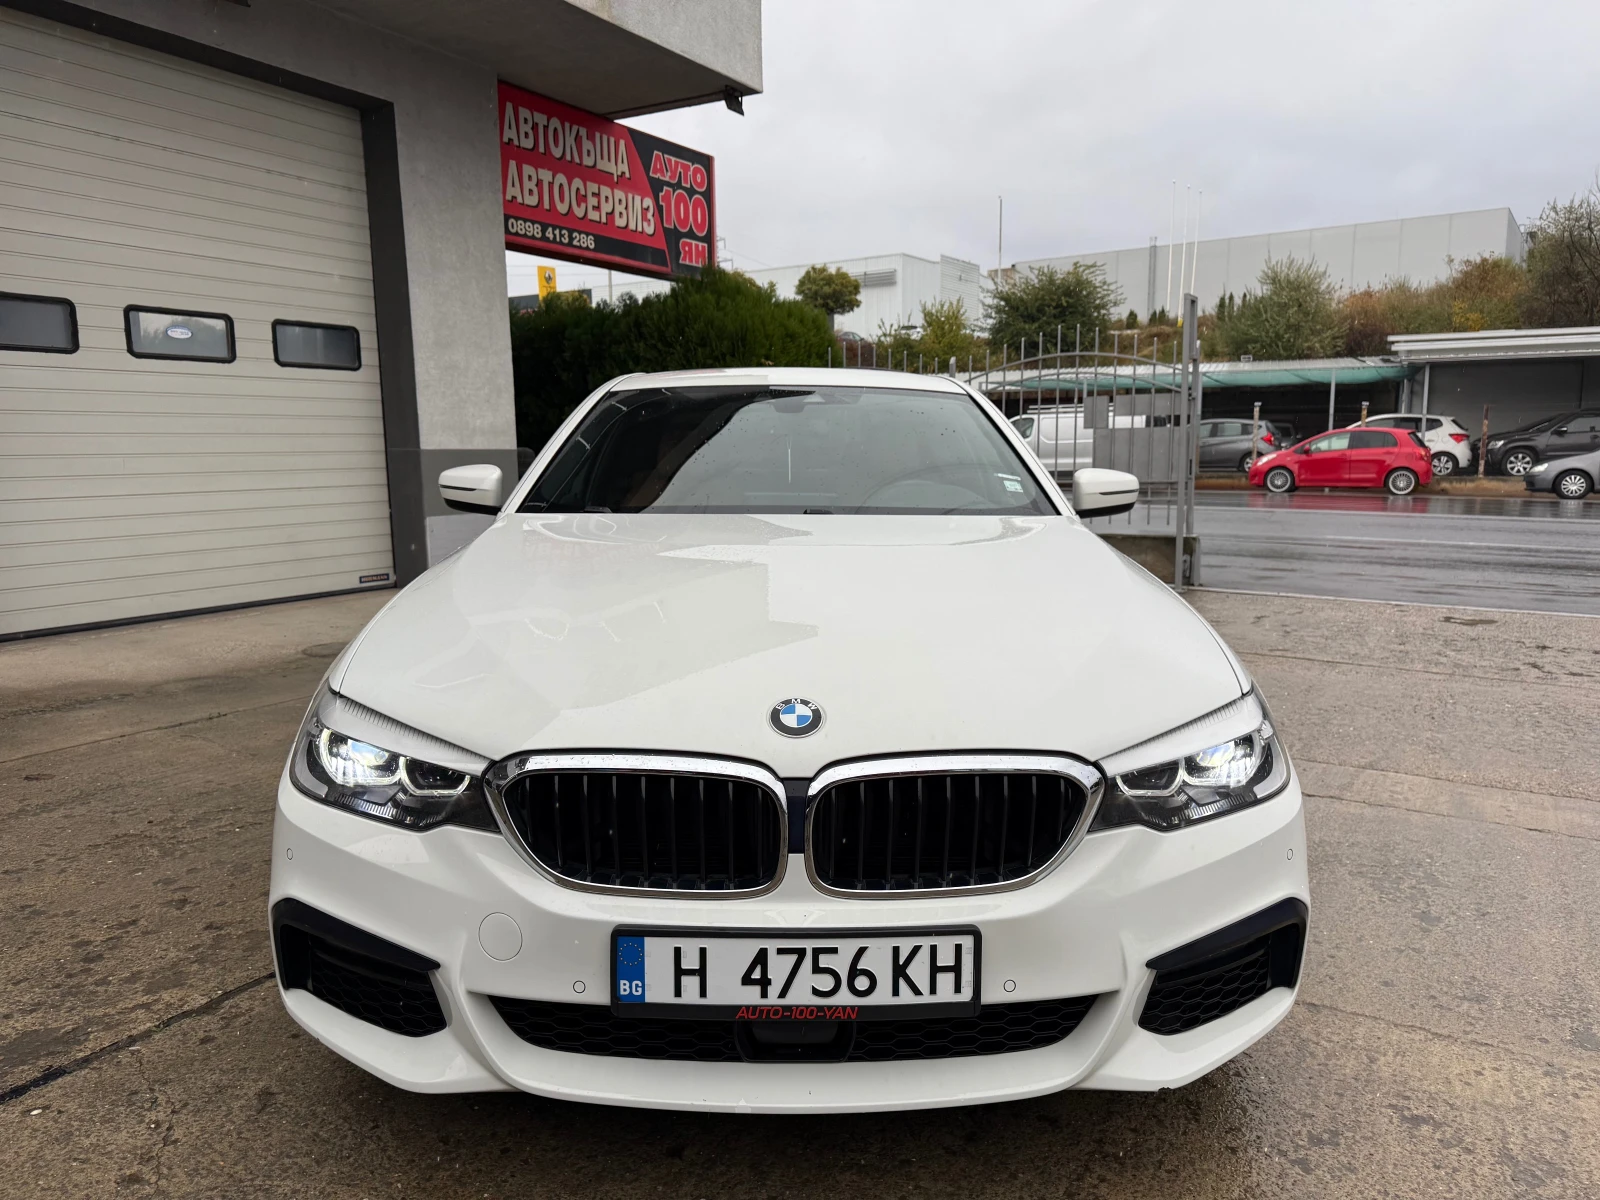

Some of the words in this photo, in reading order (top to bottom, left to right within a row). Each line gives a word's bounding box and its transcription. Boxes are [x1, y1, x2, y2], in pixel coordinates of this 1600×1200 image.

[503, 101, 630, 182] АВТОКЪЩА
[650, 150, 707, 192] АУТО
[505, 160, 655, 236] АВТОСЕРВИЗ
[659, 186, 708, 237] 100
[508, 218, 542, 238] 0898
[545, 227, 569, 244] 413
[572, 232, 595, 249] 286
[679, 238, 708, 267] ЯН
[619, 980, 643, 996] BG
[673, 946, 707, 998] H
[741, 946, 878, 998] 4756
[891, 943, 963, 996] KH
[735, 1006, 859, 1020] AUTO-100-YAN
